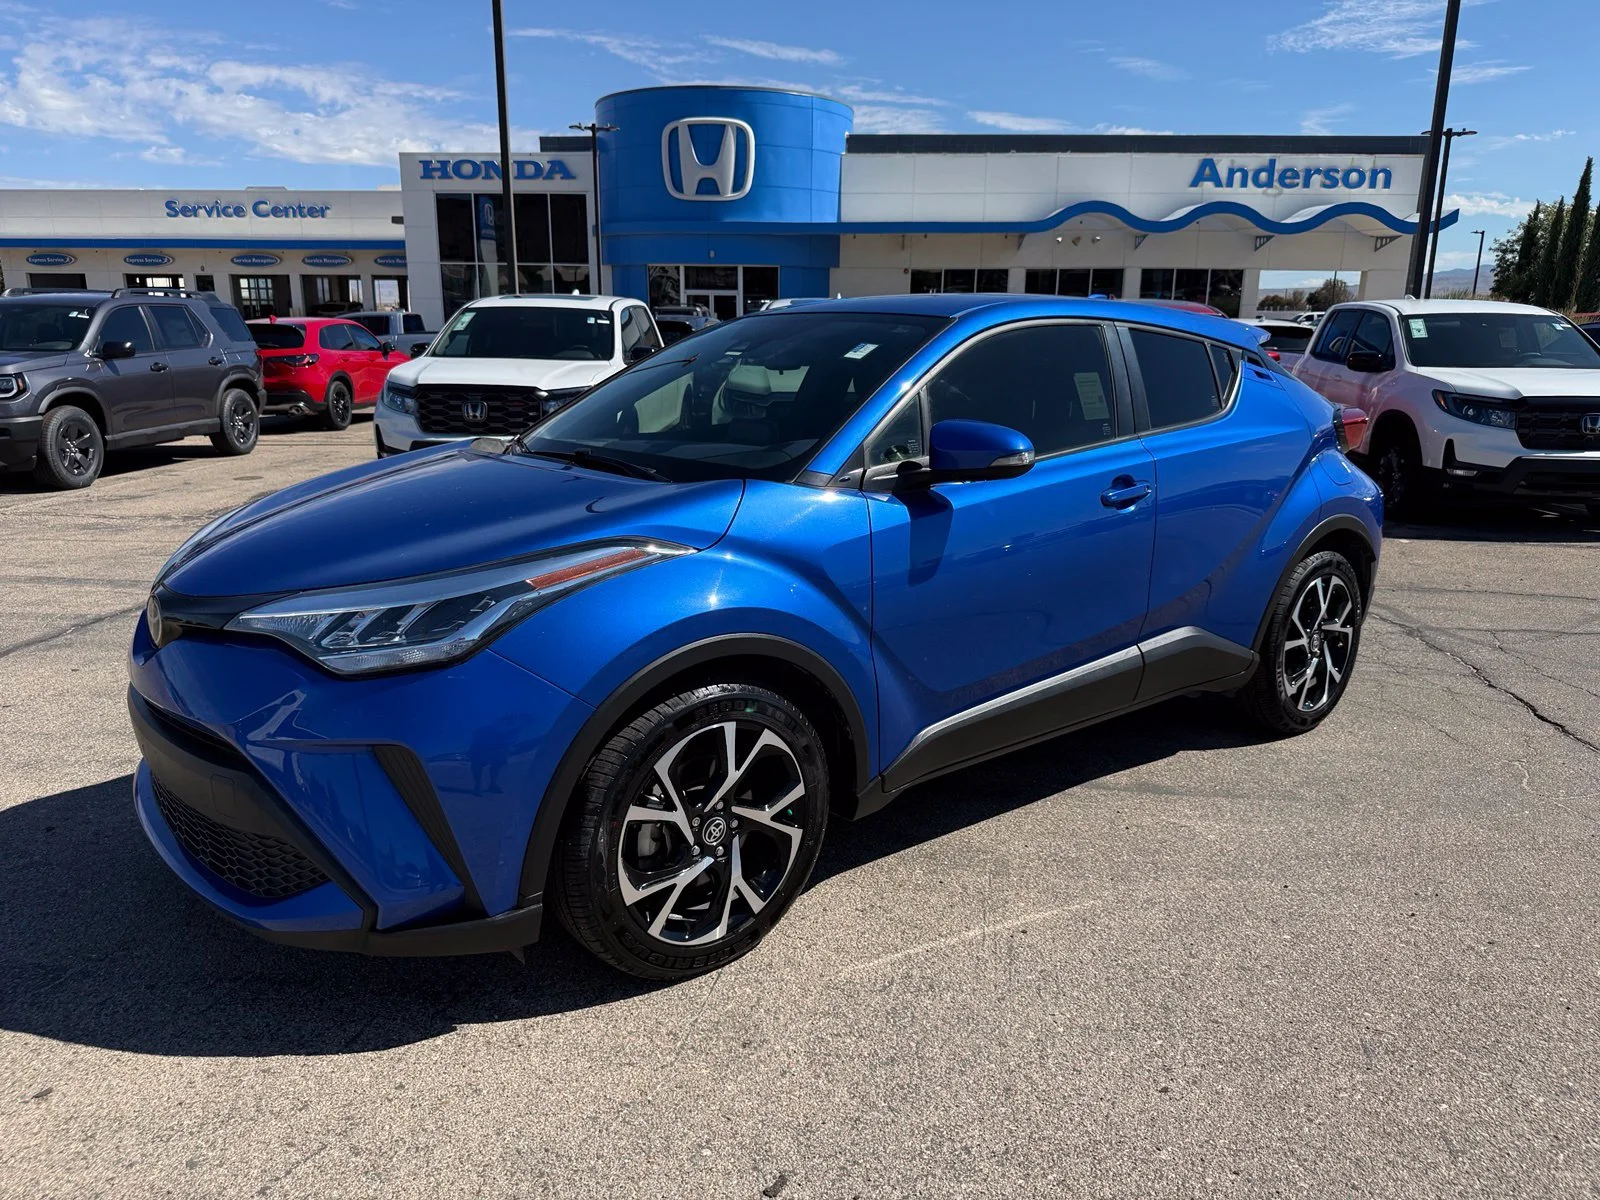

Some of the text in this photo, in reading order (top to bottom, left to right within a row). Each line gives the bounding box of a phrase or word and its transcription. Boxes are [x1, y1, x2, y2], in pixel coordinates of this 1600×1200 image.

[418, 159, 577, 180] HONDA
[1189, 157, 1392, 189] Anderson
[164, 200, 331, 219] Service Center
